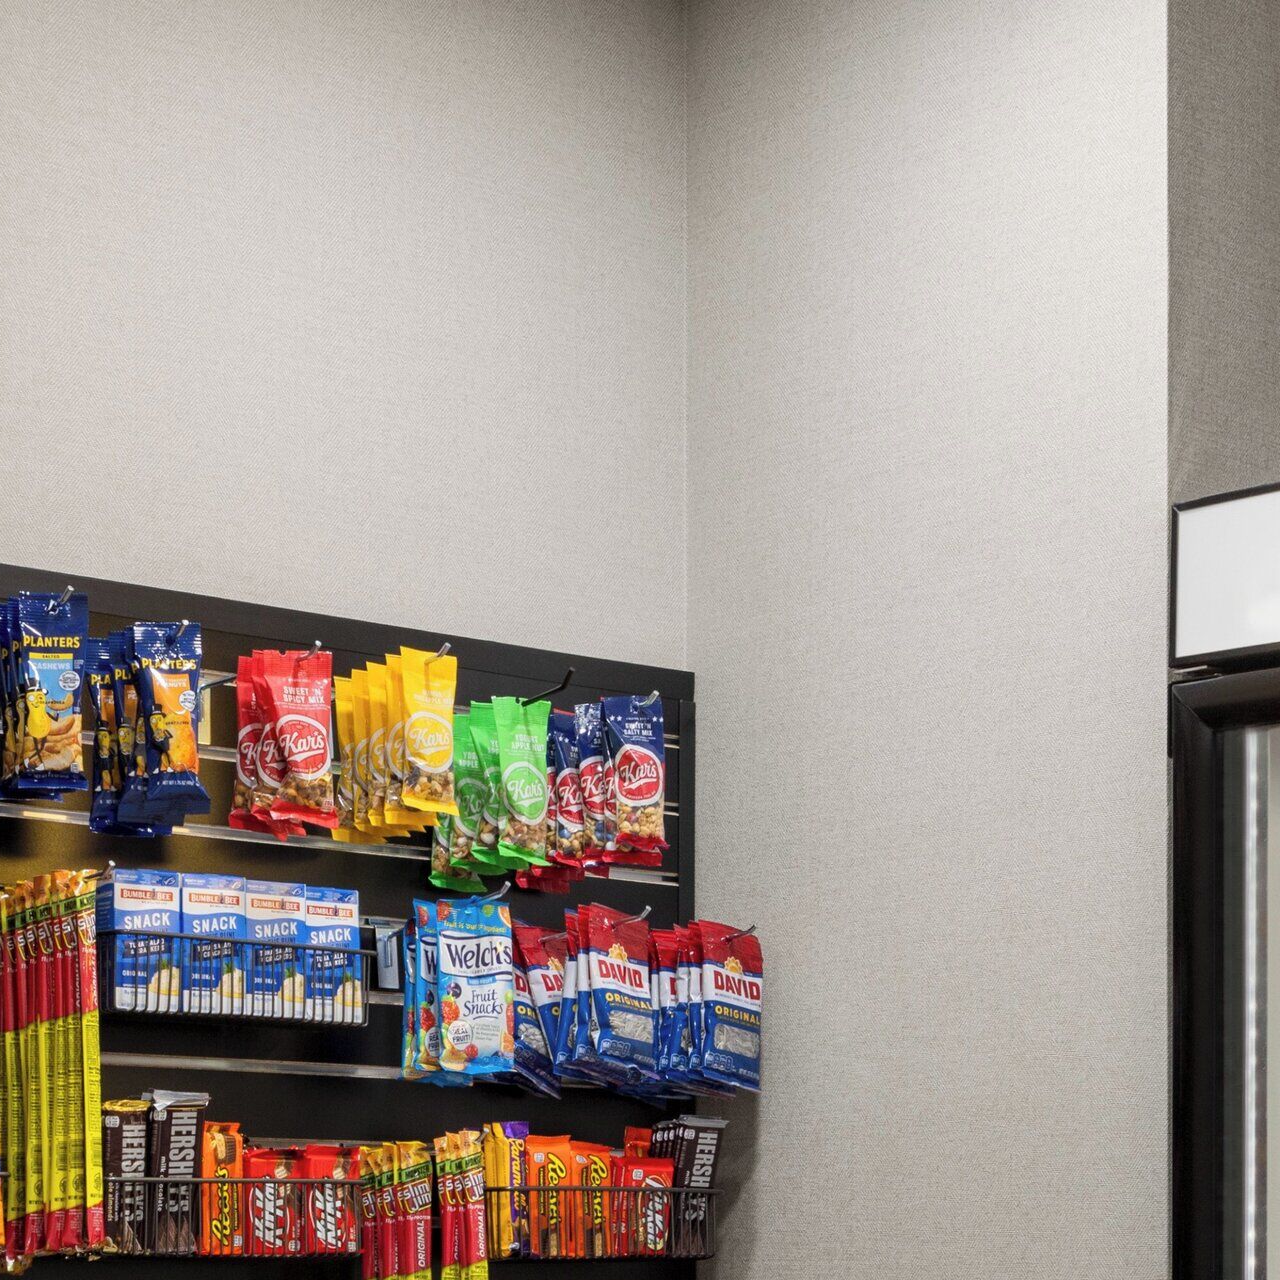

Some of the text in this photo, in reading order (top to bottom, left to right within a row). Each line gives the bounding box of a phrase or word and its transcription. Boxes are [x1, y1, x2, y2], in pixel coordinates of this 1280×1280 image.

[23, 636, 80, 649] PLANTERS
[308, 696, 325, 704] MIX
[279, 731, 325, 756] Kar's
[621, 760, 657, 784] Kar's
[508, 779, 543, 799] Kar's
[122, 889, 172, 901] BUMBLE BEE
[190, 894, 239, 905] BUMBLE BEE
[253, 899, 300, 910] BUMBLE BEE
[307, 906, 352, 917] BUMBLE BEE
[124, 912, 170, 930] SNACK
[192, 916, 237, 933] SNACK
[255, 922, 298, 938] SNACK
[311, 928, 351, 944] SNACK
[446, 940, 512, 969] Welch's
[598, 958, 644, 989] DAVID
[713, 969, 761, 1001] DAVID
[471, 989, 497, 1003] Fruit
[605, 992, 653, 1010] ORIGINAL
[463, 1001, 504, 1016] Snacks
[715, 1005, 760, 1024] ORIGINAL
